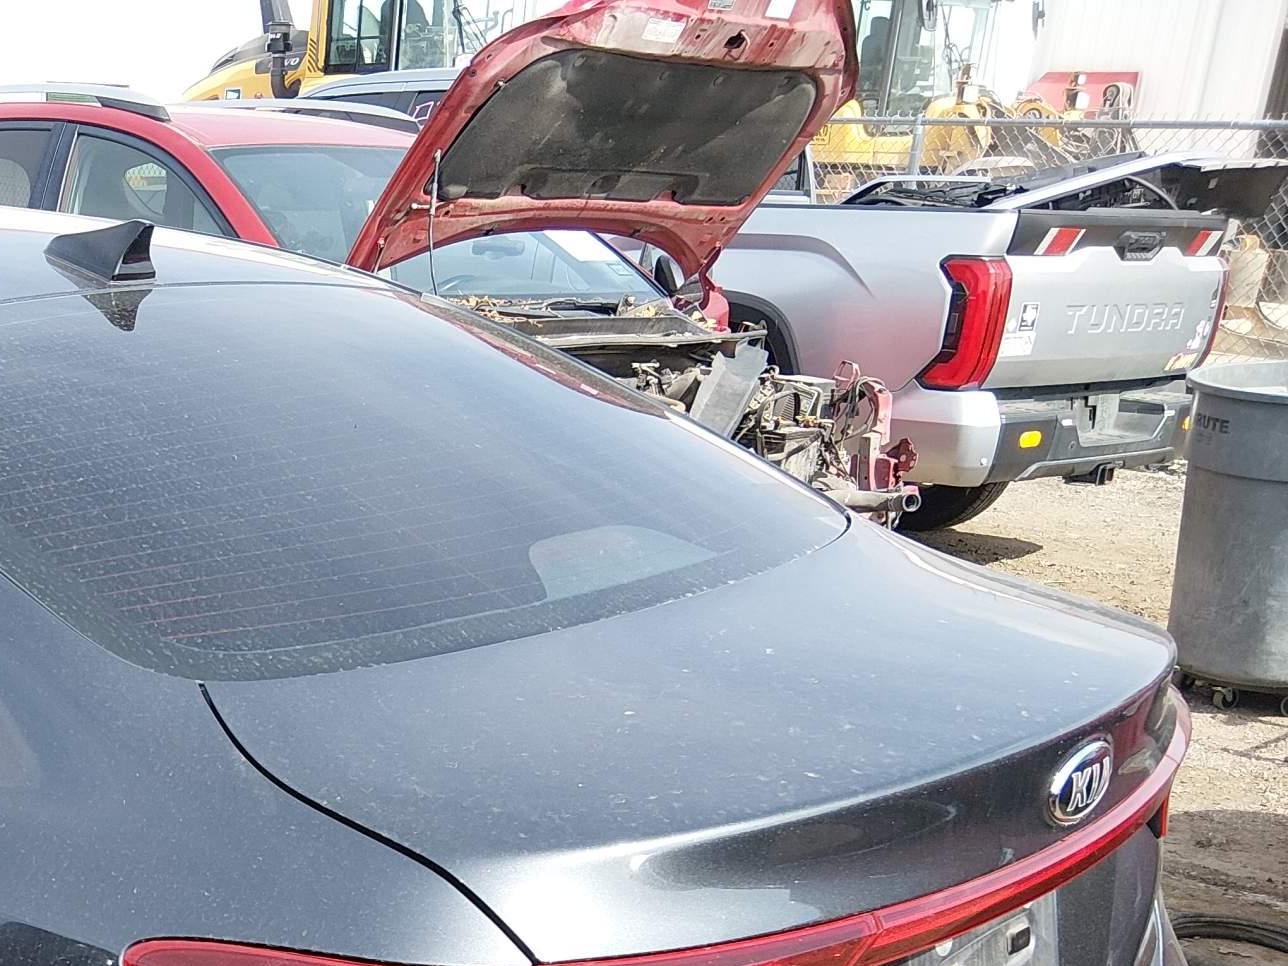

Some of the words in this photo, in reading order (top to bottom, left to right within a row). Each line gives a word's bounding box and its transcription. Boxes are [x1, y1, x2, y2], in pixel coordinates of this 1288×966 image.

[1065, 302, 1186, 335] TUNDRA
[1196, 412, 1231, 434] RUTE
[1066, 755, 1110, 812] KIA
